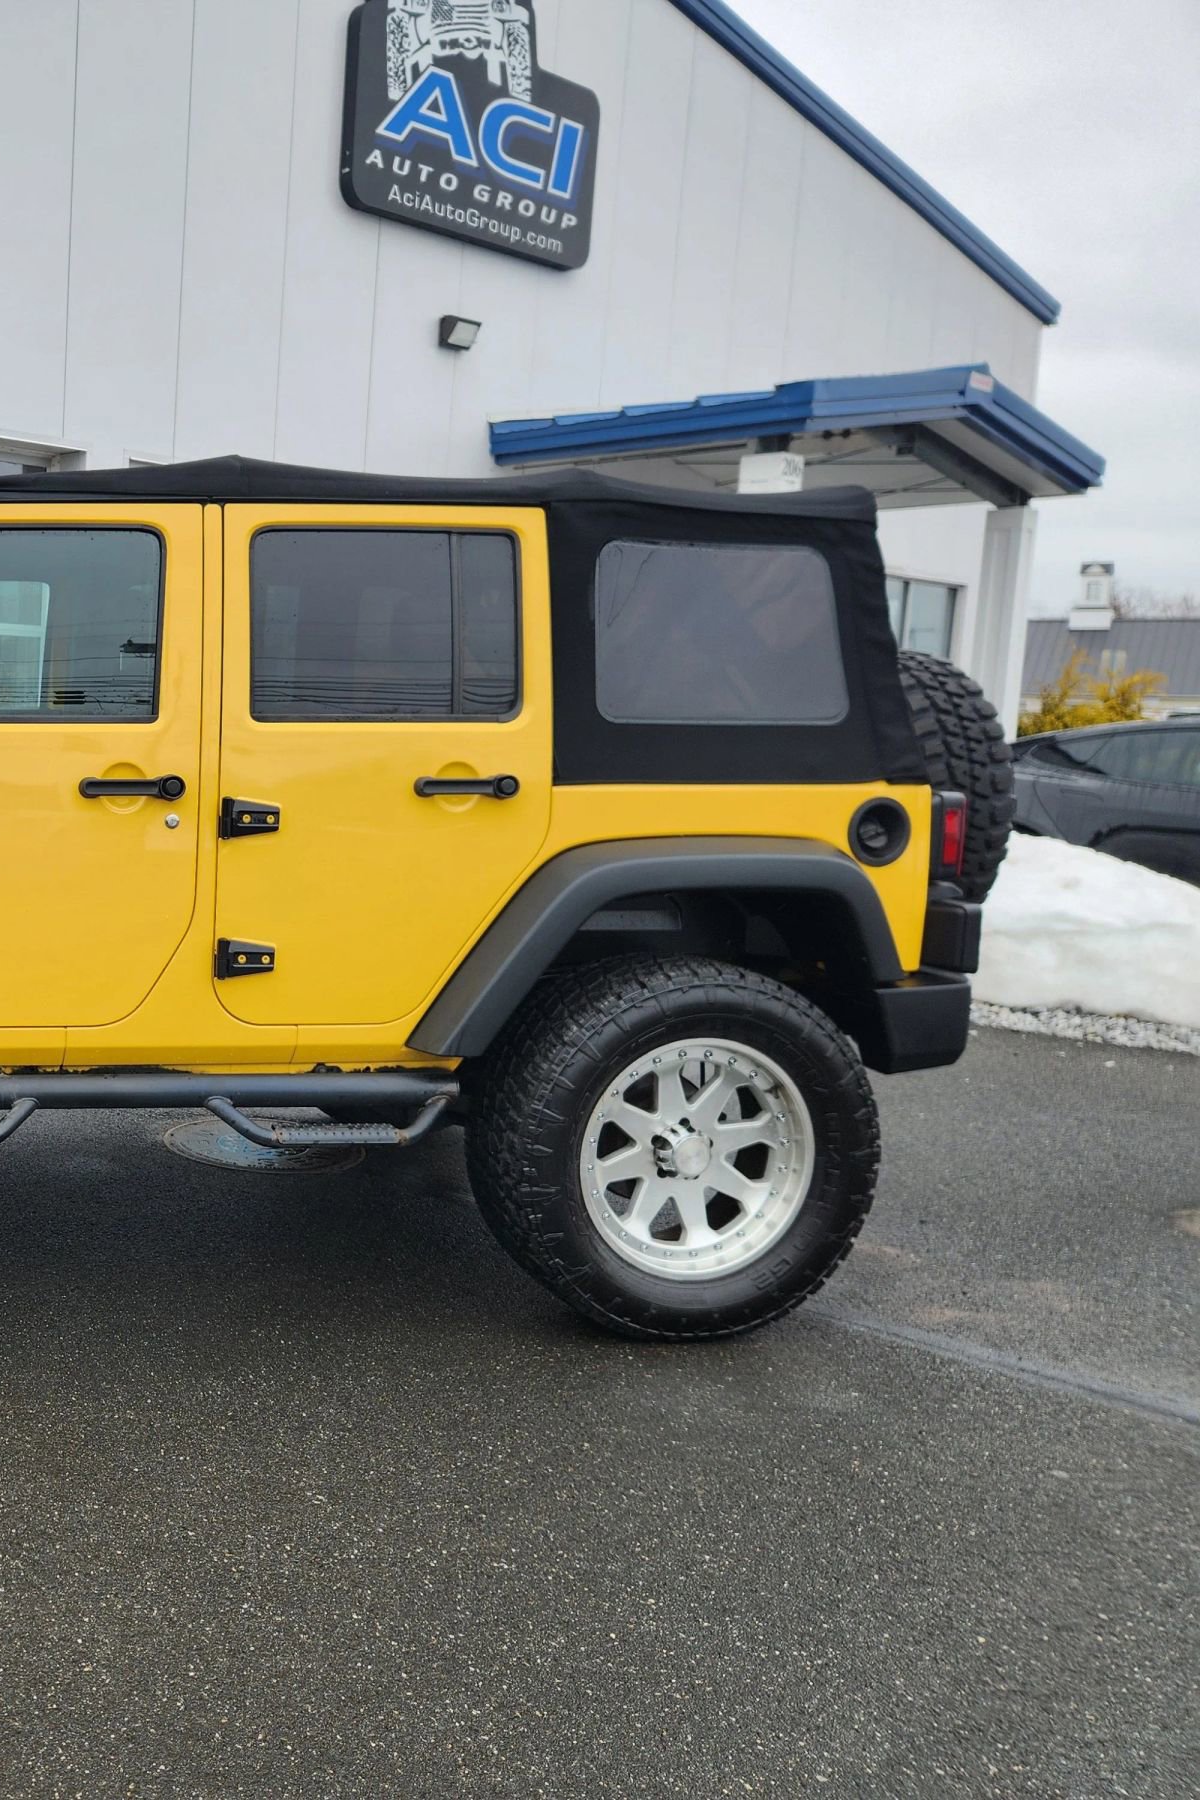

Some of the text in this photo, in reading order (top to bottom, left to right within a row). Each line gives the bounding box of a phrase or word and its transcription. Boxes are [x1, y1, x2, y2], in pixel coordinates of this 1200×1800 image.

[375, 65, 585, 199] ACI
[365, 149, 578, 229] AUTO GROUP
[388, 184, 564, 254] AciAutoGroup.com
